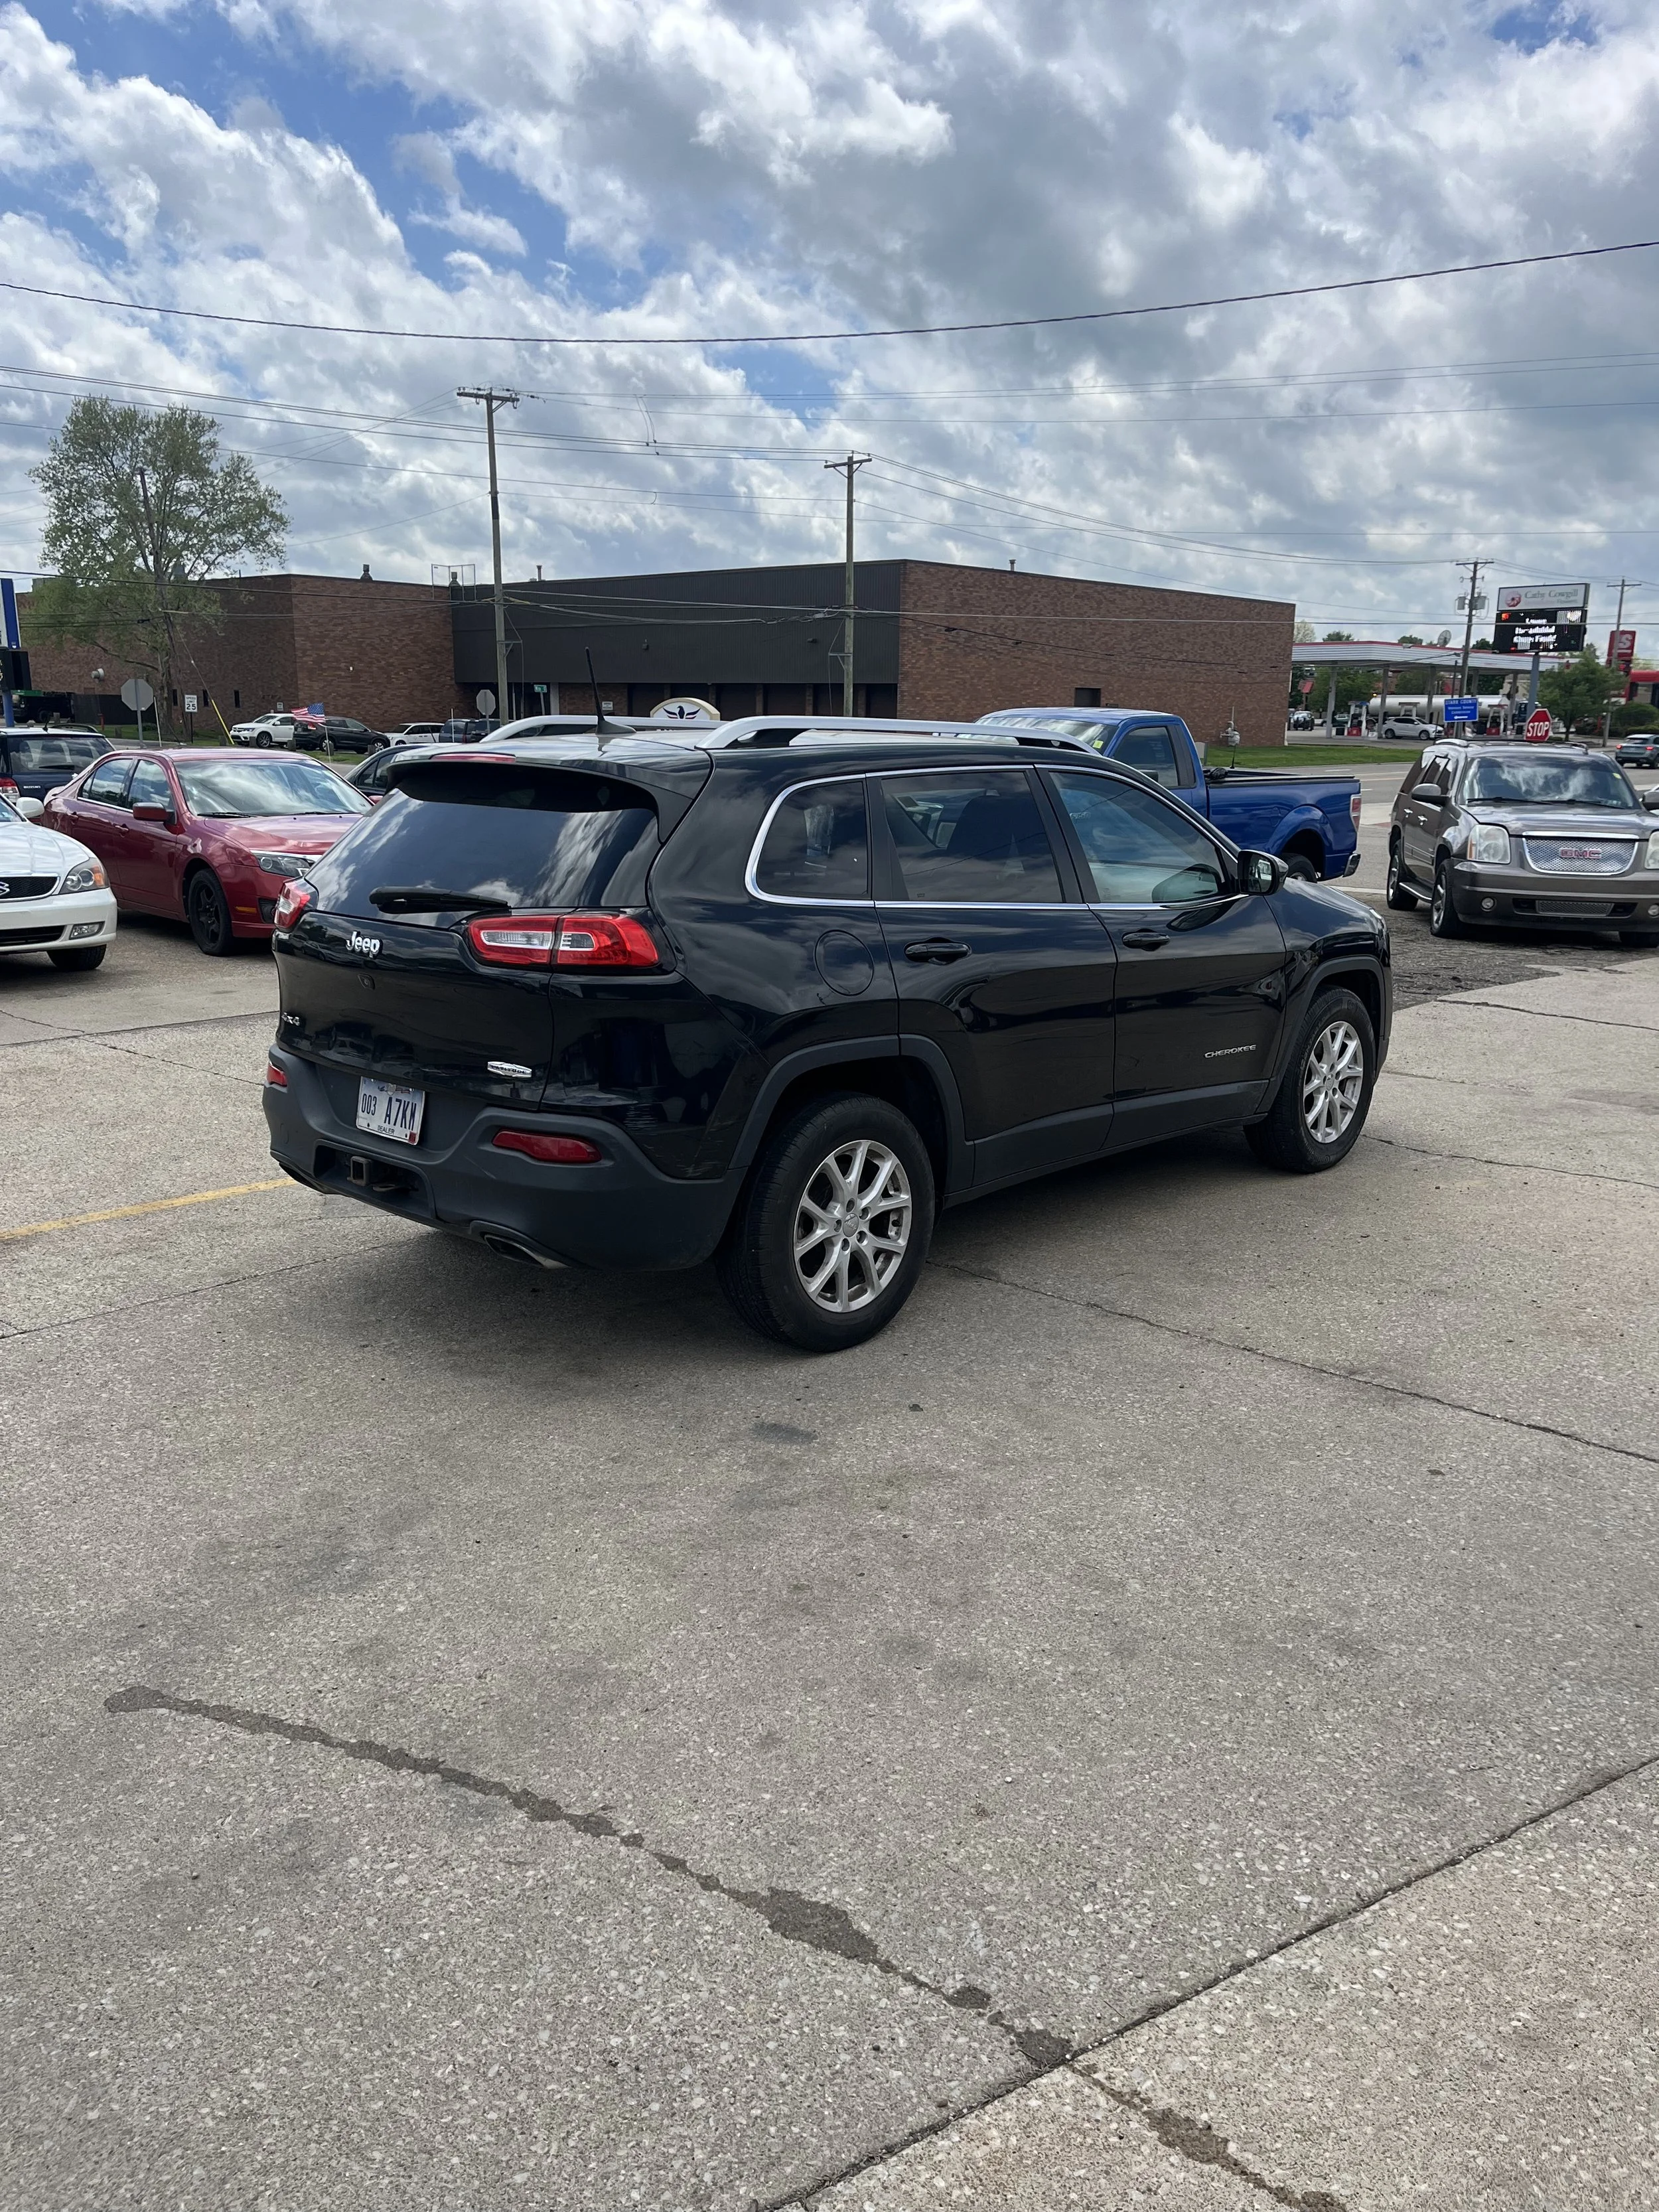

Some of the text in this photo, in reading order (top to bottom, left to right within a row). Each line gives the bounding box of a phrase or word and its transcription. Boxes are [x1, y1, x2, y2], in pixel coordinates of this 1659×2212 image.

[1527, 721, 1550, 737] STOP
[1560, 848, 1602, 859] GMC
[346, 930, 381, 958] Jeep
[1204, 1045, 1256, 1058] CHEROKEE
[361, 1093, 377, 1116] 003
[377, 1125, 396, 1135] DEALER
